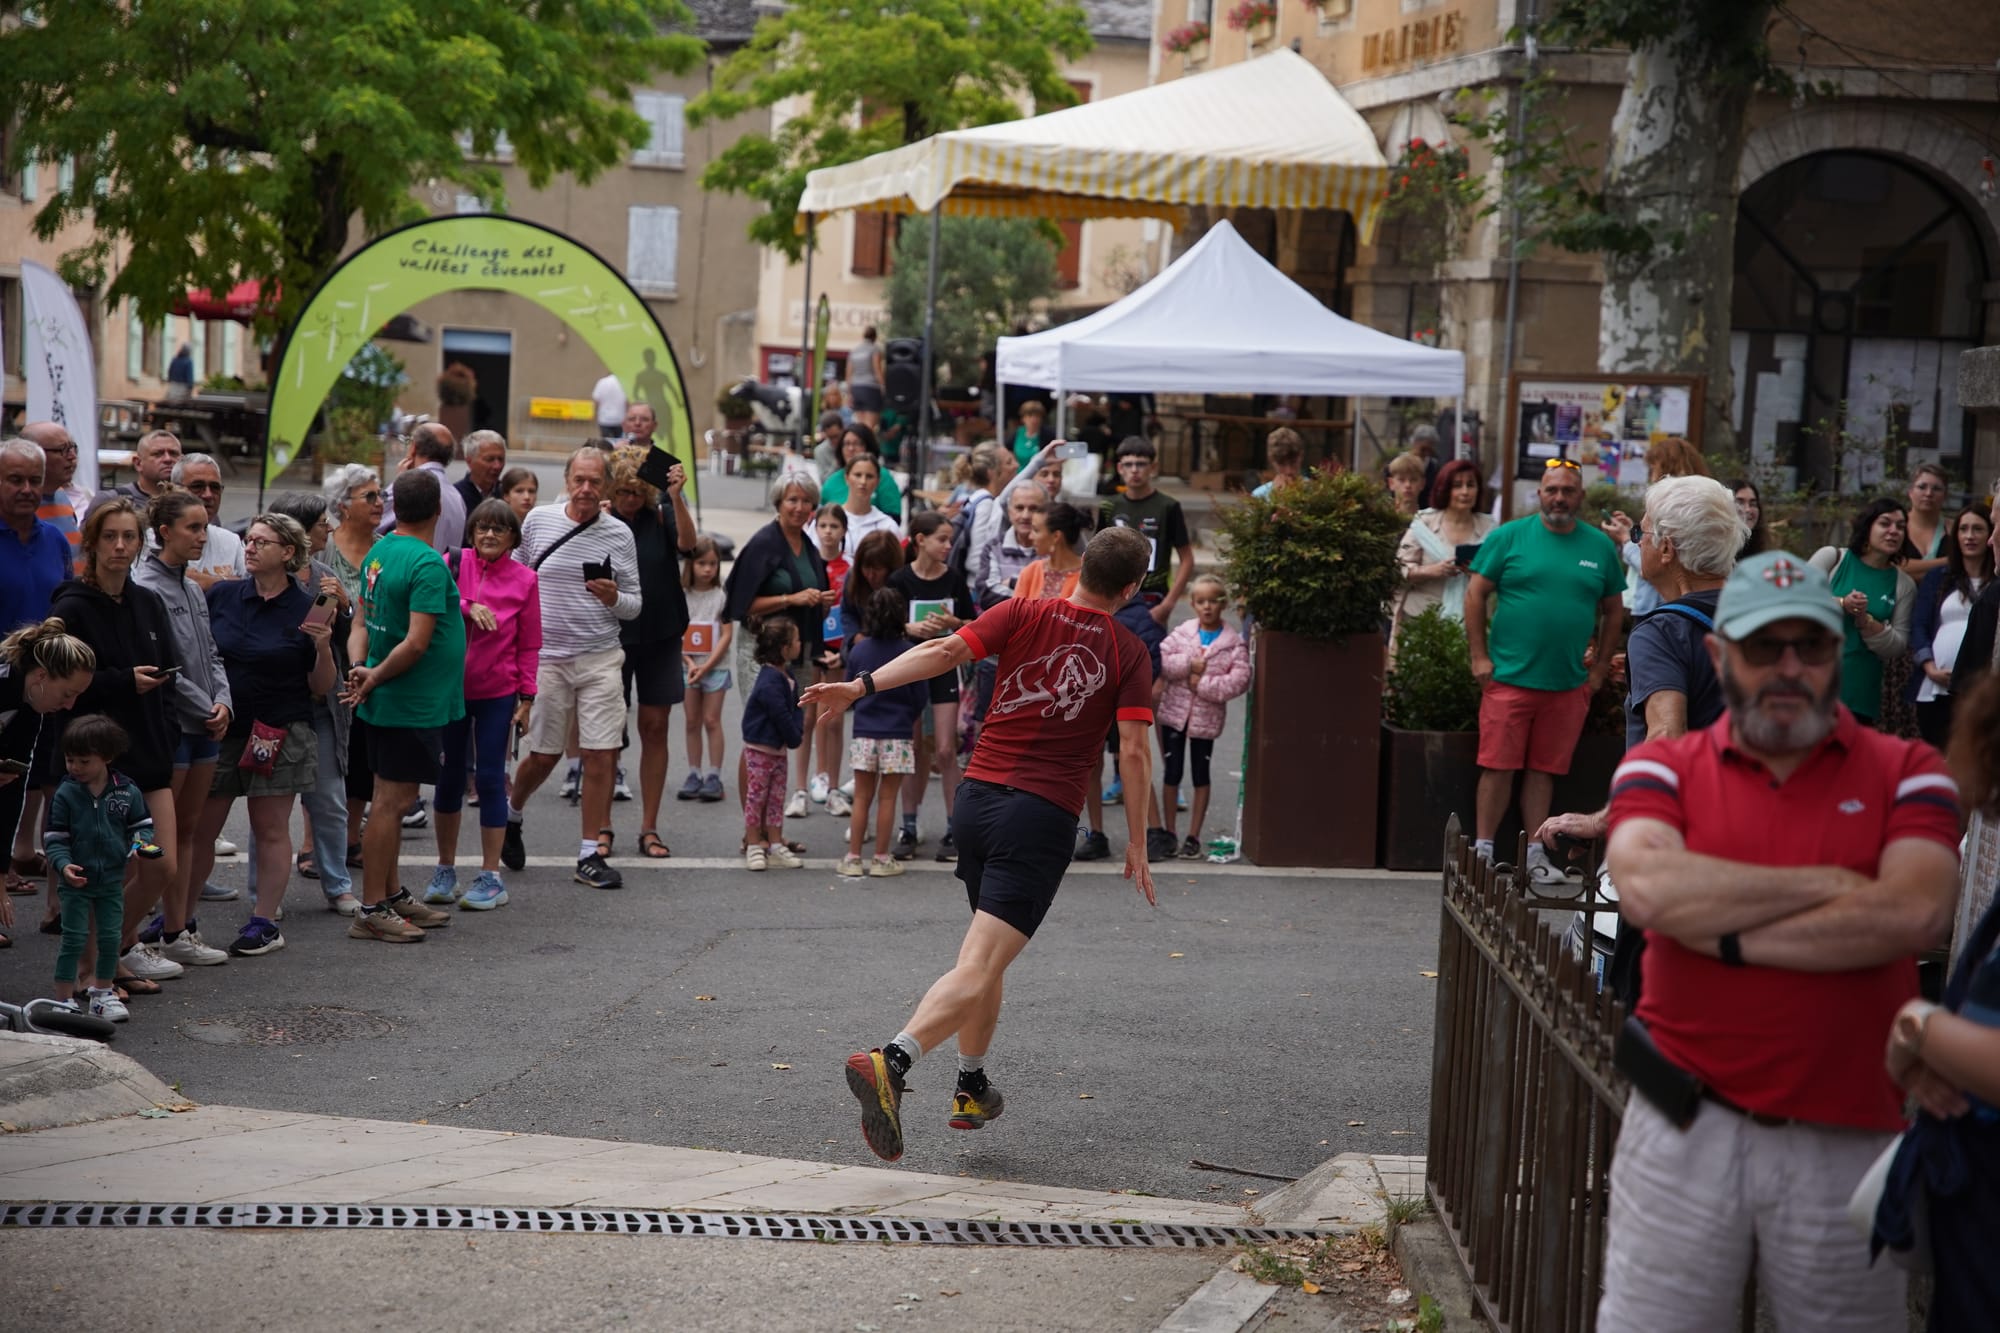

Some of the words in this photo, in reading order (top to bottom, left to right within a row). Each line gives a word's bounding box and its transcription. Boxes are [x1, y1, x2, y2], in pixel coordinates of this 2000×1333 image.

[1361, 9, 1460, 72] MAIRIE
[412, 239, 510, 263] Challenge
[522, 246, 555, 259] des
[826, 616, 836, 630] 9
[691, 631, 703, 646] 6
